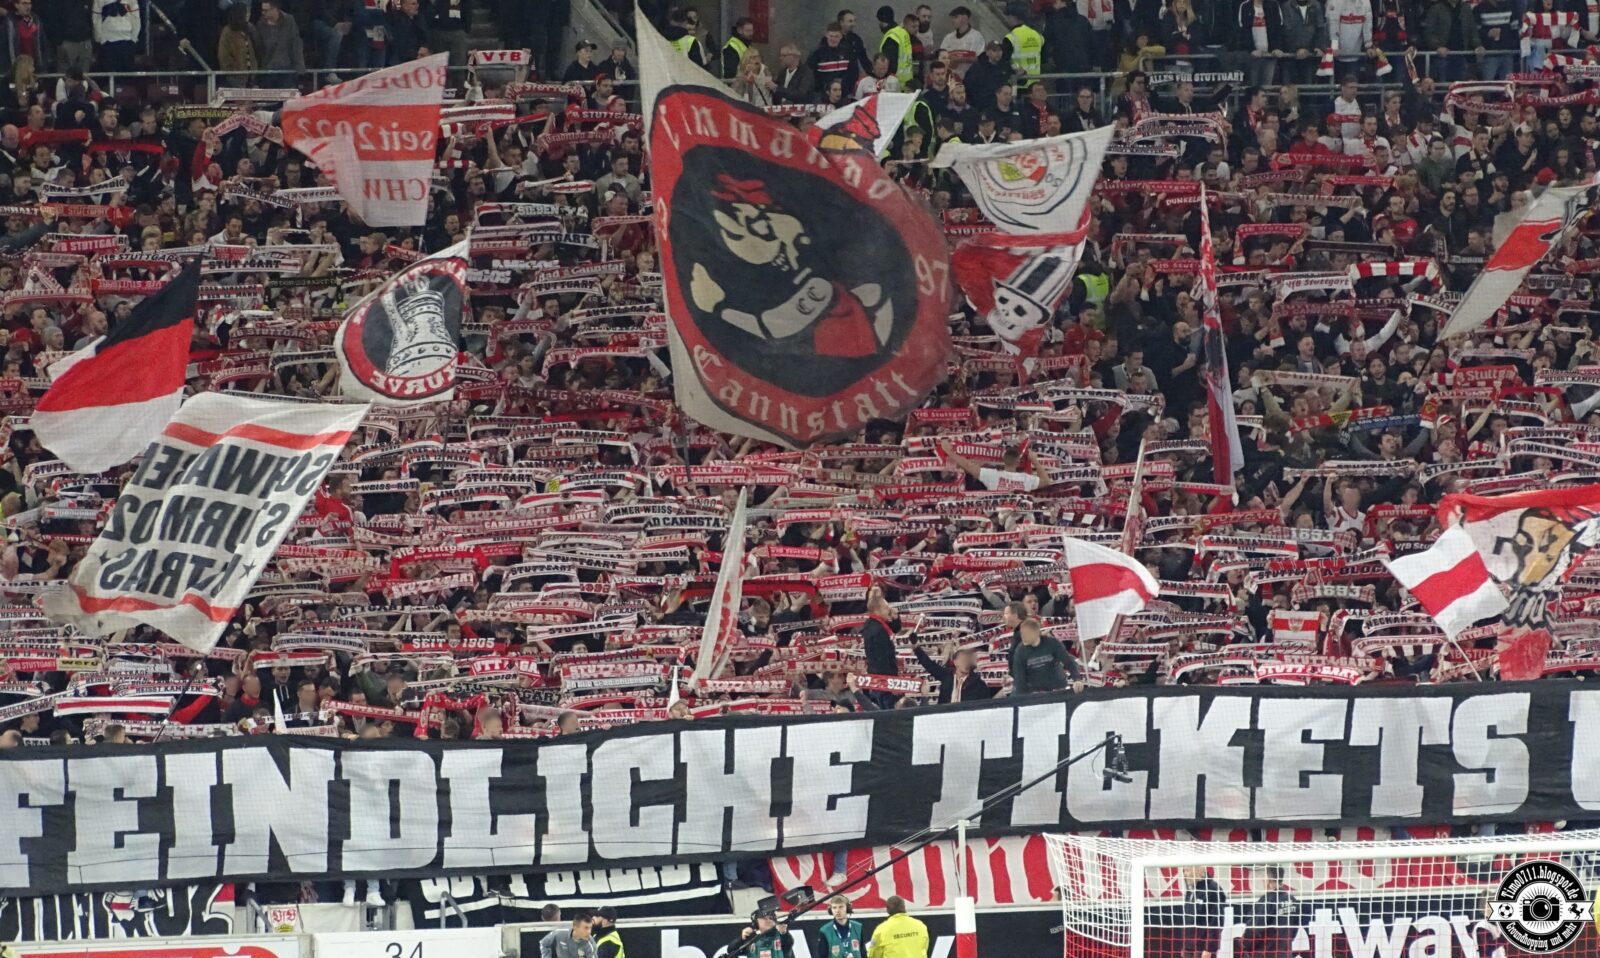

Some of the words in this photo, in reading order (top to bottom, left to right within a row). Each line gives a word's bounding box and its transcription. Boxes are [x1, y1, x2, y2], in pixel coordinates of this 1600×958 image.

[482, 53, 521, 63] VfB
[529, 234, 589, 246] UTTGART
[914, 254, 948, 303] 97
[694, 345, 918, 438] Cannstatt
[466, 473, 533, 486] STUTTGART
[643, 504, 673, 517] WEISS
[1209, 536, 1285, 549] CANNSTATTER
[1395, 541, 1412, 551] VfB
[418, 544, 476, 556] Stuttgart
[994, 549, 1057, 563] Stuttgart
[933, 619, 961, 630] WEISS
[1366, 612, 1409, 630] NECKAR
[412, 638, 446, 650] SEIT
[462, 638, 494, 650] 1905
[858, 675, 872, 688] 97
[886, 678, 922, 693] SZENE
[0, 718, 875, 889] FEINDLICHE
[911, 692, 1531, 832] TICKETS
[893, 931, 919, 940] SECURITY
[385, 941, 423, 958] 34
